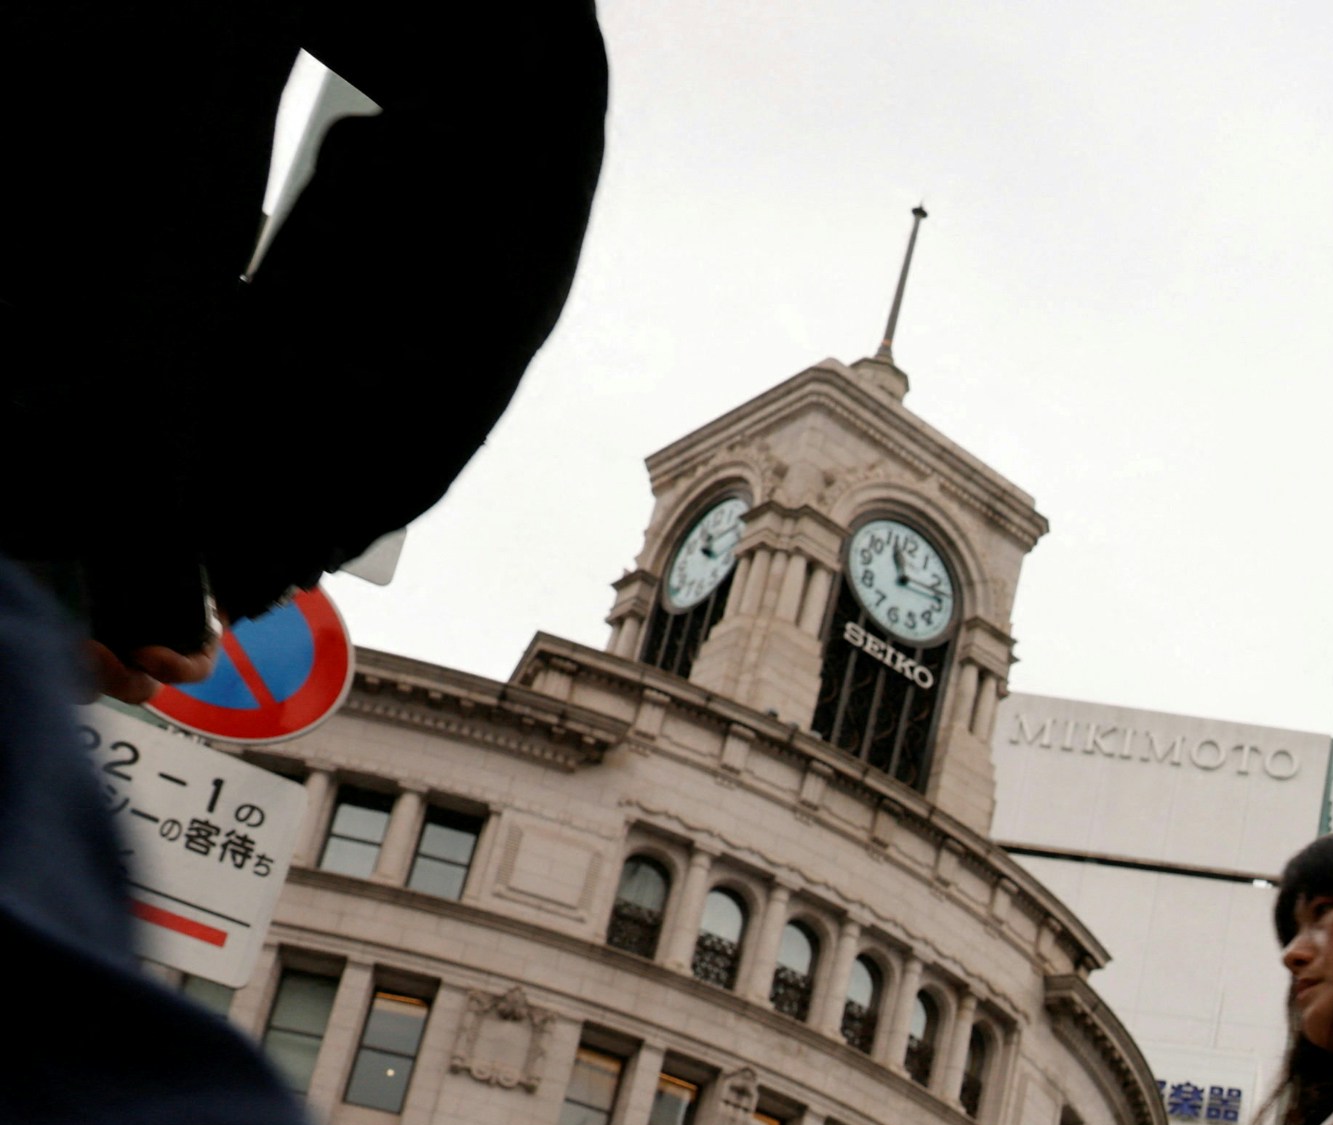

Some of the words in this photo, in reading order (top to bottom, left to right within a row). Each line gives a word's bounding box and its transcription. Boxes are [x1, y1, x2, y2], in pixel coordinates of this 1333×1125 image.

[867, 534, 884, 555] 10
[902, 536, 919, 559] 12
[860, 549, 873, 566] 9
[861, 569, 875, 589] 8
[874, 589, 887, 607] 7
[886, 606, 900, 624] 6
[904, 610, 917, 630] 5
[843, 621, 934, 690] SEIKO
[1008, 712, 1300, 782] MIKIMOTO
